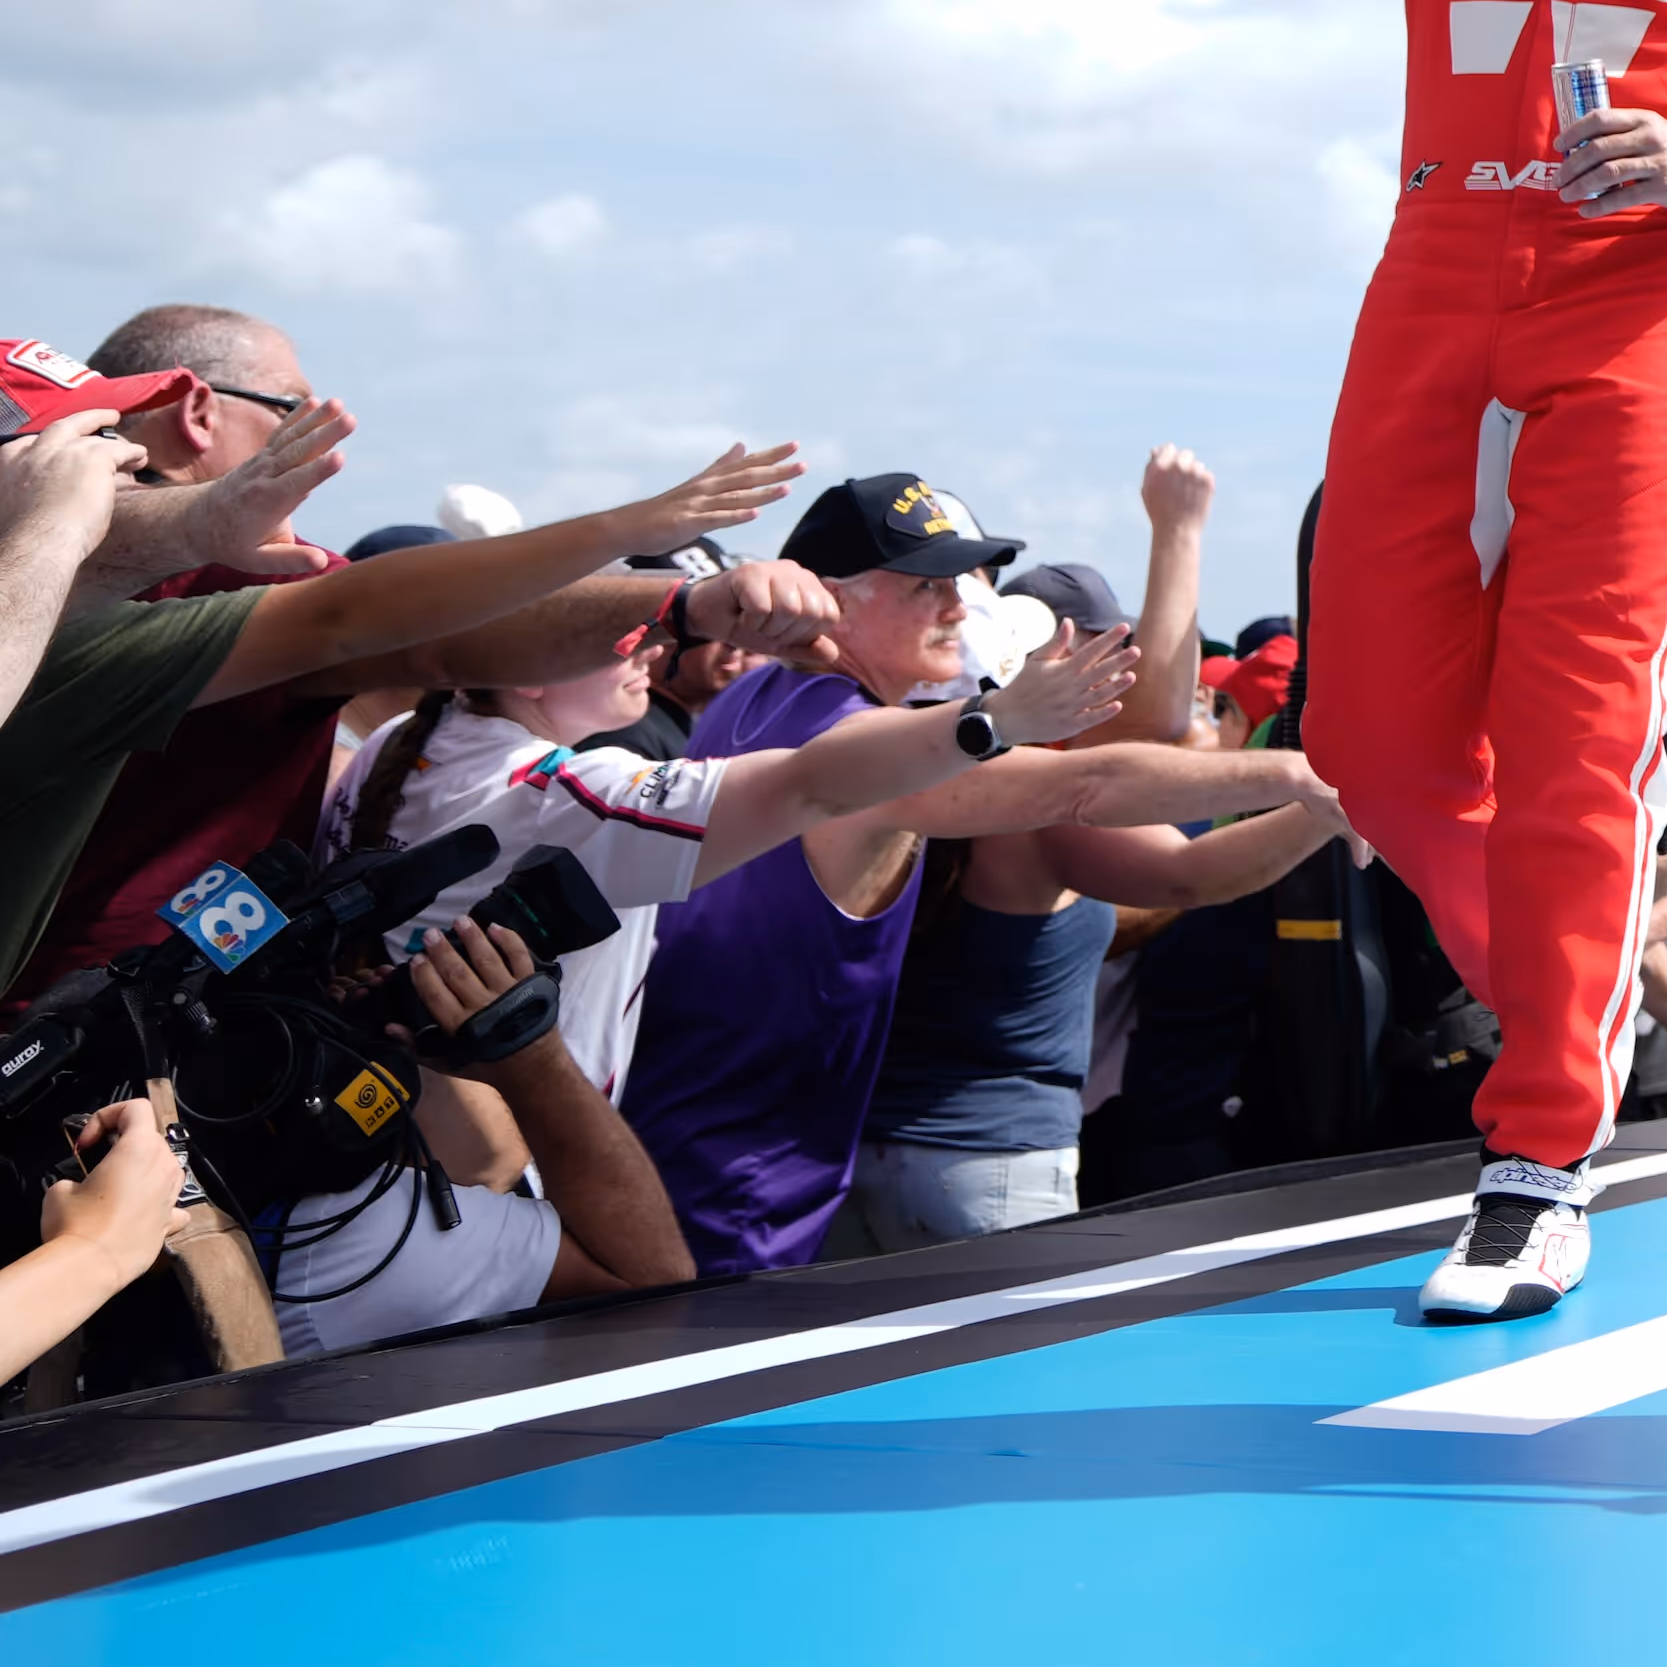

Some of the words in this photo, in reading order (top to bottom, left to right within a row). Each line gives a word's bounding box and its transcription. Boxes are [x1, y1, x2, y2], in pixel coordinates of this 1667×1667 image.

[171, 869, 226, 914] 8
[200, 891, 266, 950] 8
[1, 1039, 41, 1077] auray
